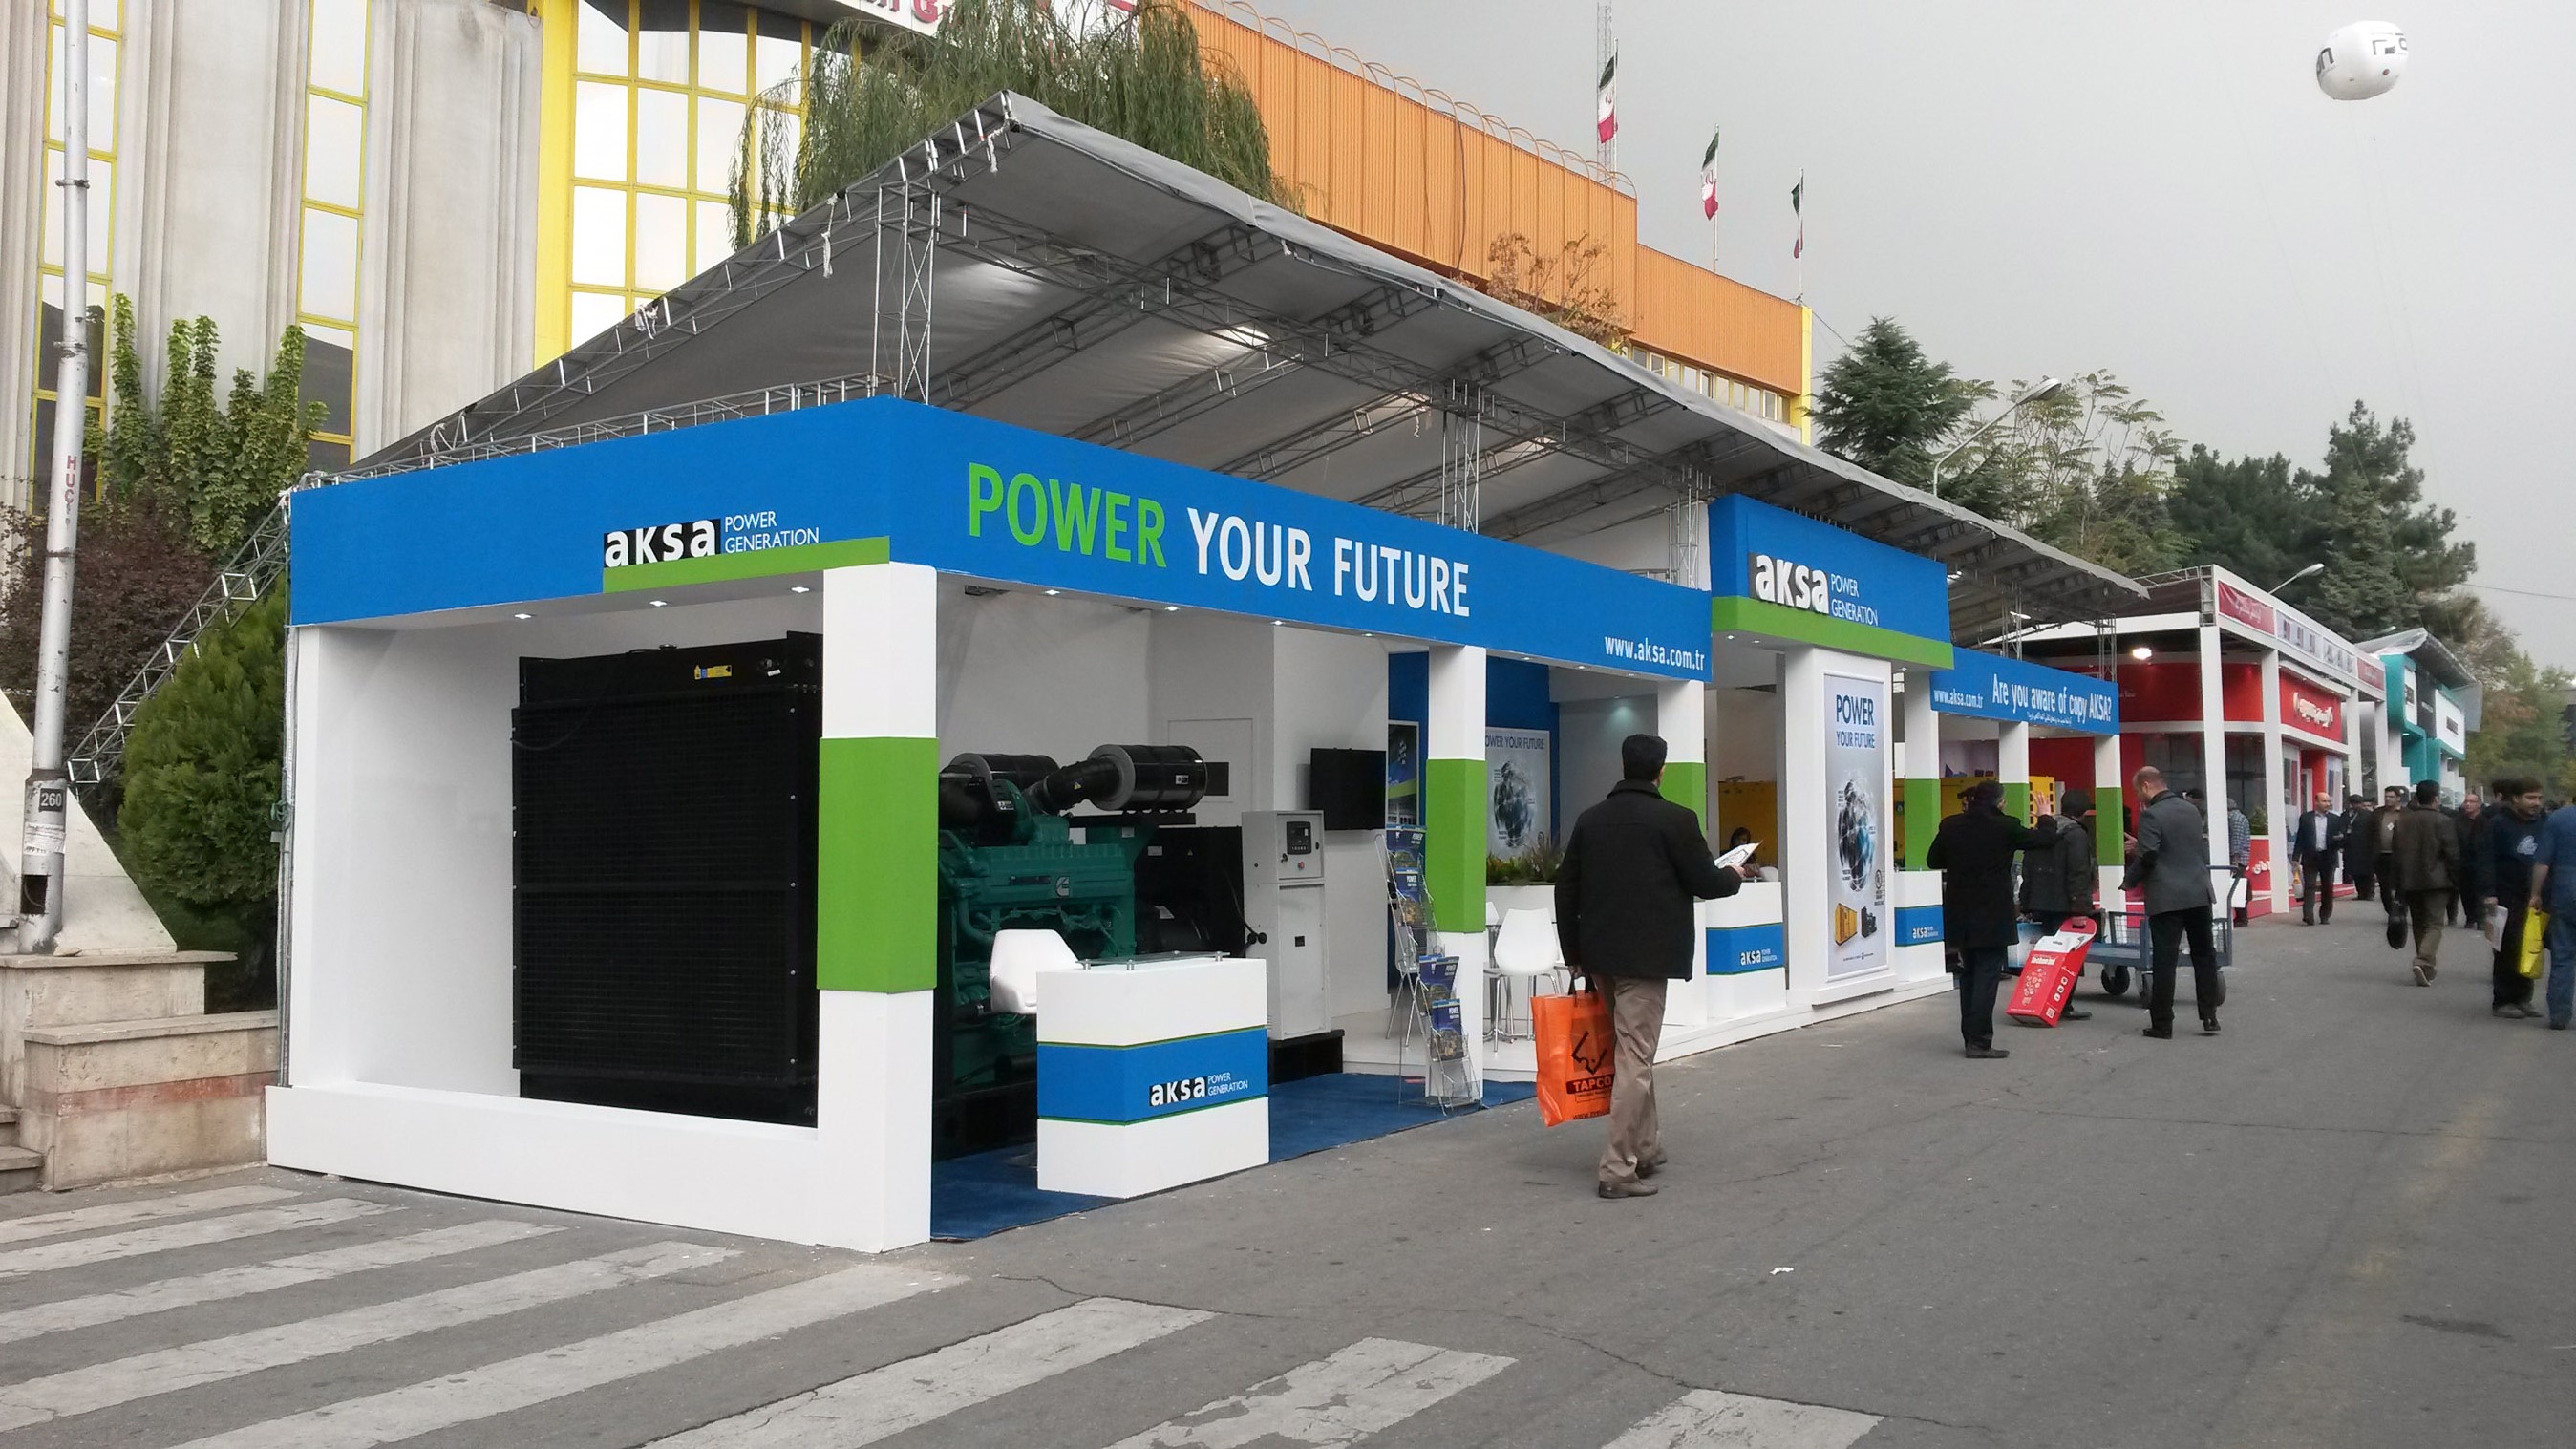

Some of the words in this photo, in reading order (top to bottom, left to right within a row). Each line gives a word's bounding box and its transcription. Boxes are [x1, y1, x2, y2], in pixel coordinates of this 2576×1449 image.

[724, 510, 777, 533] POWER
[604, 519, 716, 568] aksa
[724, 526, 820, 554] GENERATION
[968, 461, 1166, 568] POWER
[1186, 505, 1313, 592] YOUR
[1333, 536, 1471, 618] FUTURE
[1755, 554, 1830, 615] aksa
[1830, 573, 1860, 598] POWER
[1830, 598, 1879, 627] GENERATION
[1604, 636, 1705, 671] www.aksa.com.tr
[1836, 694, 1874, 726] POWER
[1933, 688, 1984, 709] www.aksa.com.tr
[1991, 673, 2009, 706] Are
[2011, 683, 2029, 714] you
[2031, 687, 2055, 712] aware
[2057, 685, 2067, 714] of
[2068, 693, 2088, 724] copy
[2088, 693, 2113, 723] AKSA?
[1485, 735, 1503, 748] OWER
[1504, 736, 1522, 749] YOUR
[1523, 737, 1544, 750] FUTURE
[1836, 731, 1853, 747] YOUR
[1854, 732, 1875, 749] FUTURE
[40, 792, 62, 808] 260
[1740, 949, 1761, 966] aksa
[1207, 1072, 1232, 1085] POWER
[1207, 1080, 1248, 1097] GENERATION
[1572, 1076, 1612, 1092] TAPCO
[1150, 1076, 1206, 1107] aksa
